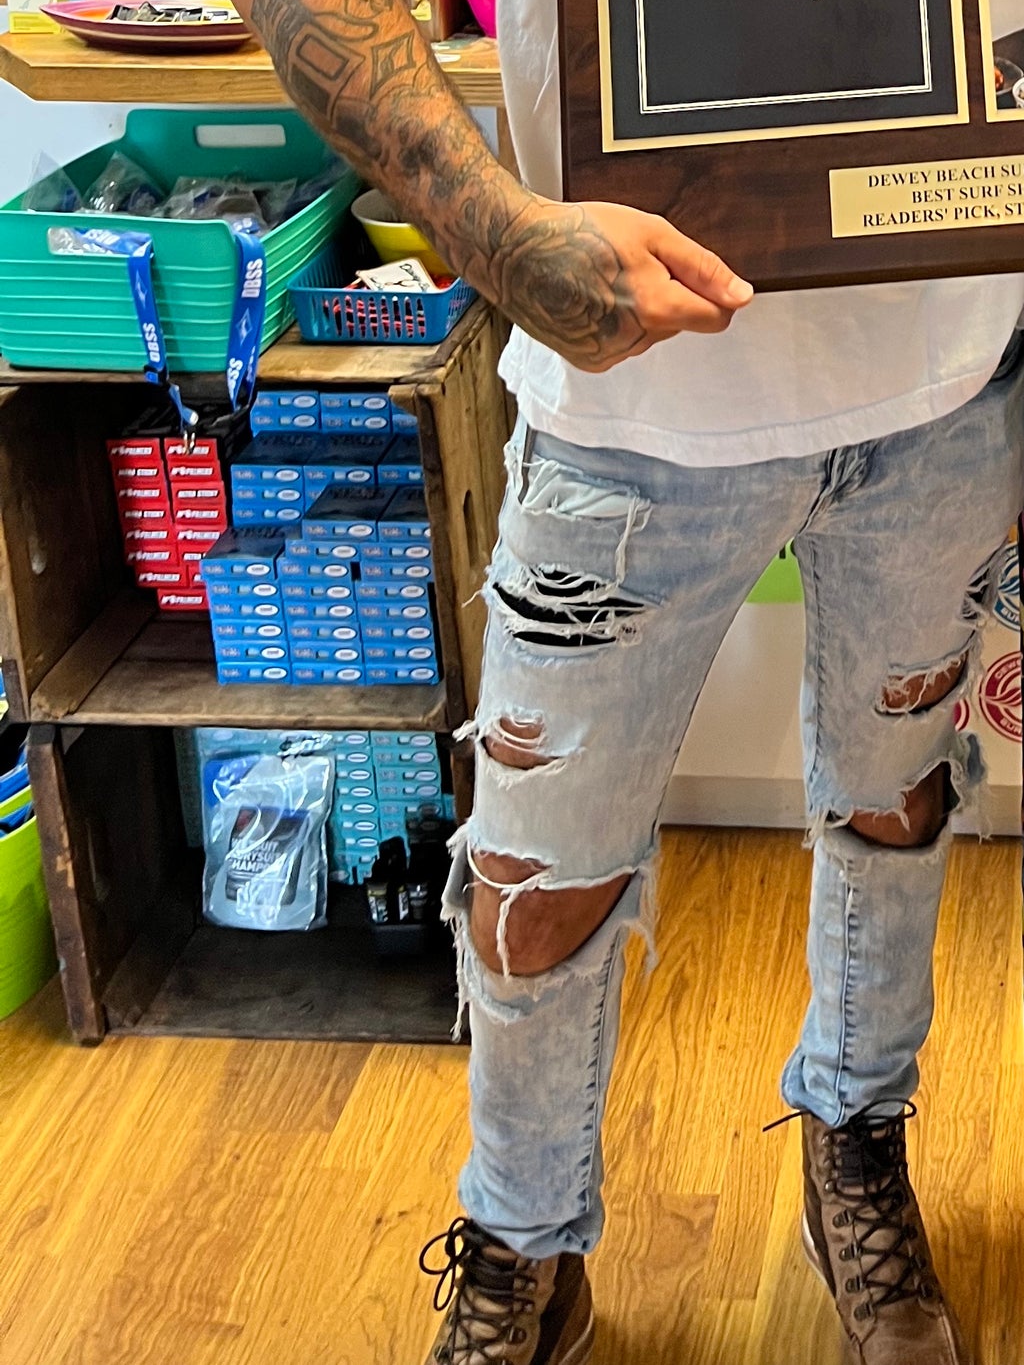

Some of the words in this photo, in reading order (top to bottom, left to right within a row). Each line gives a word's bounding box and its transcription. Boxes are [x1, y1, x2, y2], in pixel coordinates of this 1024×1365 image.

[868, 170, 932, 188] DEWEY
[936, 164, 996, 183] BEACH
[911, 189, 953, 204] BEST
[958, 183, 1003, 201] SURF
[862, 207, 949, 228] READERS'
[953, 203, 1001, 221] PICK,
